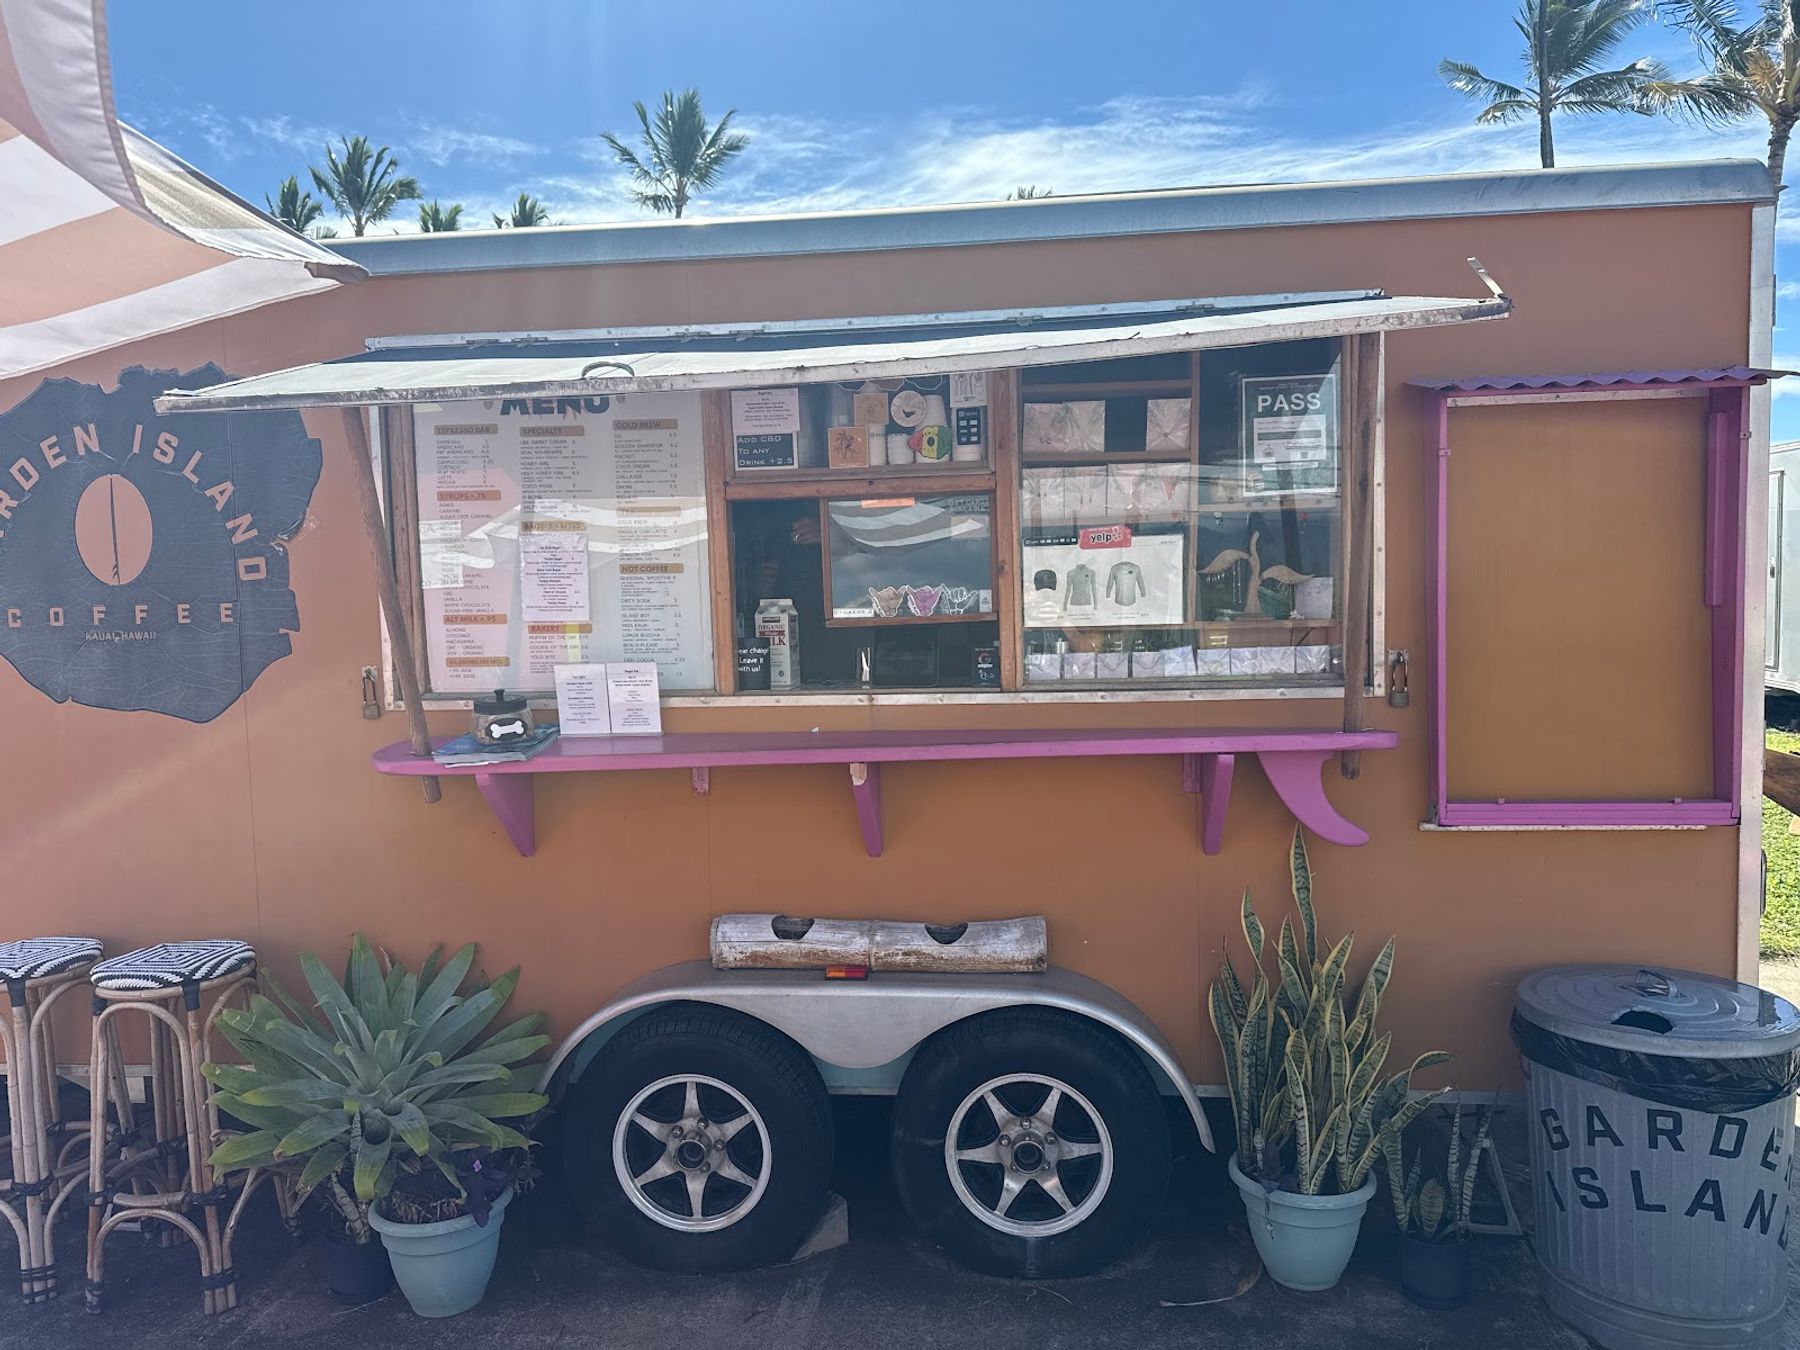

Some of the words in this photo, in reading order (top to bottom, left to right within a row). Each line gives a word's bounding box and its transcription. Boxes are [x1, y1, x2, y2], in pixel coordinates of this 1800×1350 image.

[500, 396, 609, 416] MENU
[1257, 392, 1321, 412] PASS
[522, 427, 563, 435] SPECIALTY
[760, 435, 782, 443] CBD
[0, 423, 101, 537] RDEN
[132, 424, 268, 581] ISLAND
[1090, 533, 1112, 545] yelp
[639, 564, 669, 572] COFFEE
[7, 603, 234, 628] COFFEE
[121, 631, 157, 640] HAWAII
